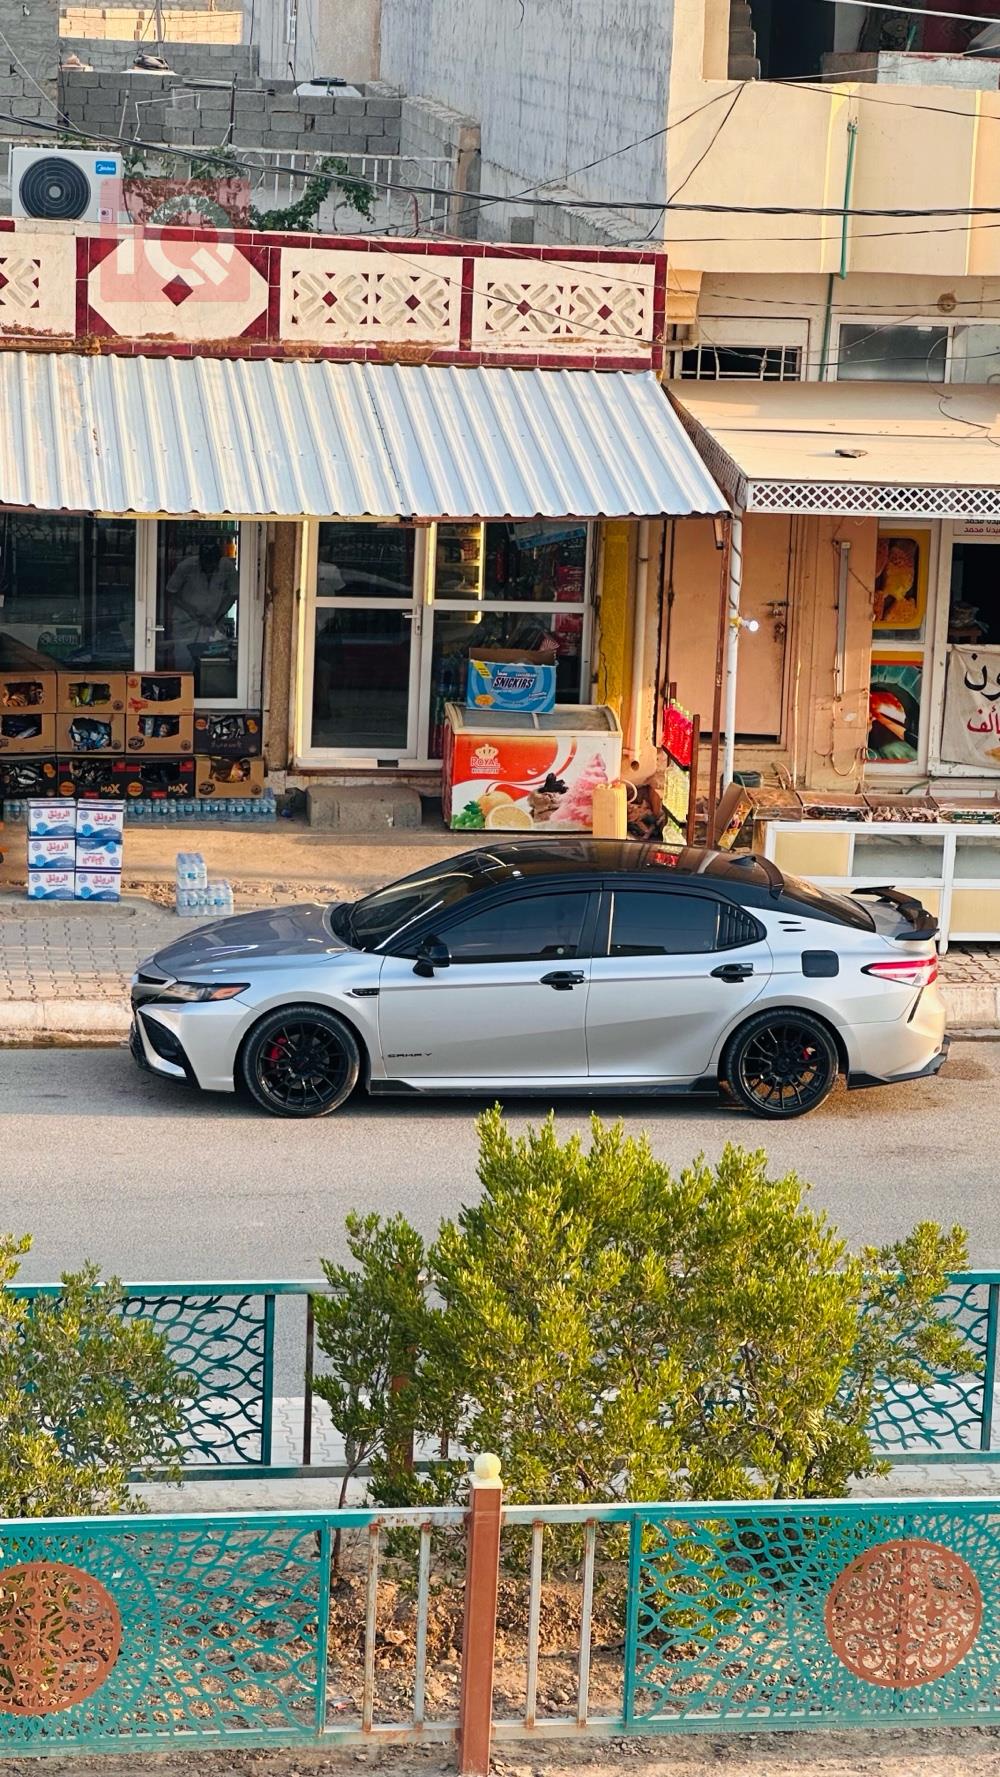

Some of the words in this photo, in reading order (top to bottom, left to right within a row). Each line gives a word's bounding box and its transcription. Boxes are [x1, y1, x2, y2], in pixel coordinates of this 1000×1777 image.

[470, 757, 501, 769] ROYAL
[100, 783, 121, 794] MAX
[167, 783, 188, 794] MAX
